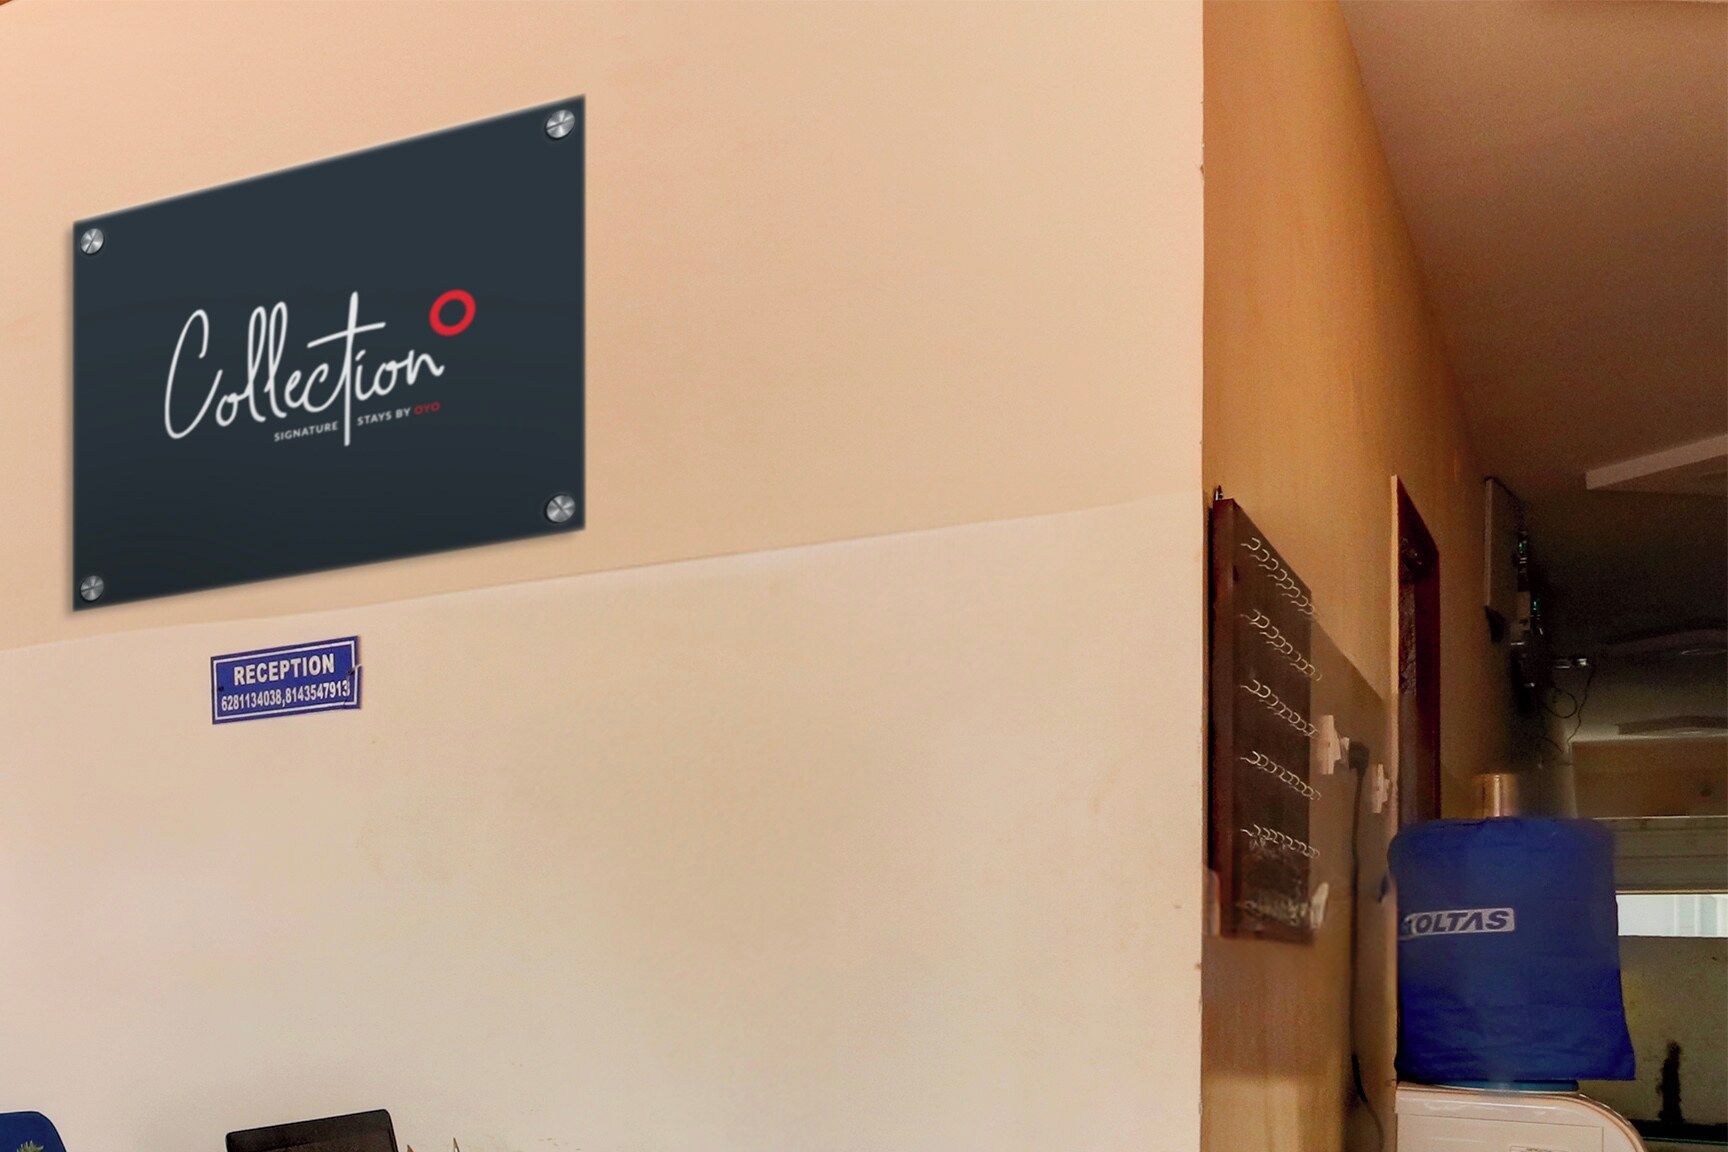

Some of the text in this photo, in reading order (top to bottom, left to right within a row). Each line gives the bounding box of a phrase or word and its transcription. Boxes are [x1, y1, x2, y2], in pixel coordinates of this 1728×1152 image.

[165, 291, 445, 446] Collection
[273, 401, 442, 442] SIGNATURE STAYS BY OYO
[233, 653, 335, 686] RECEPTION
